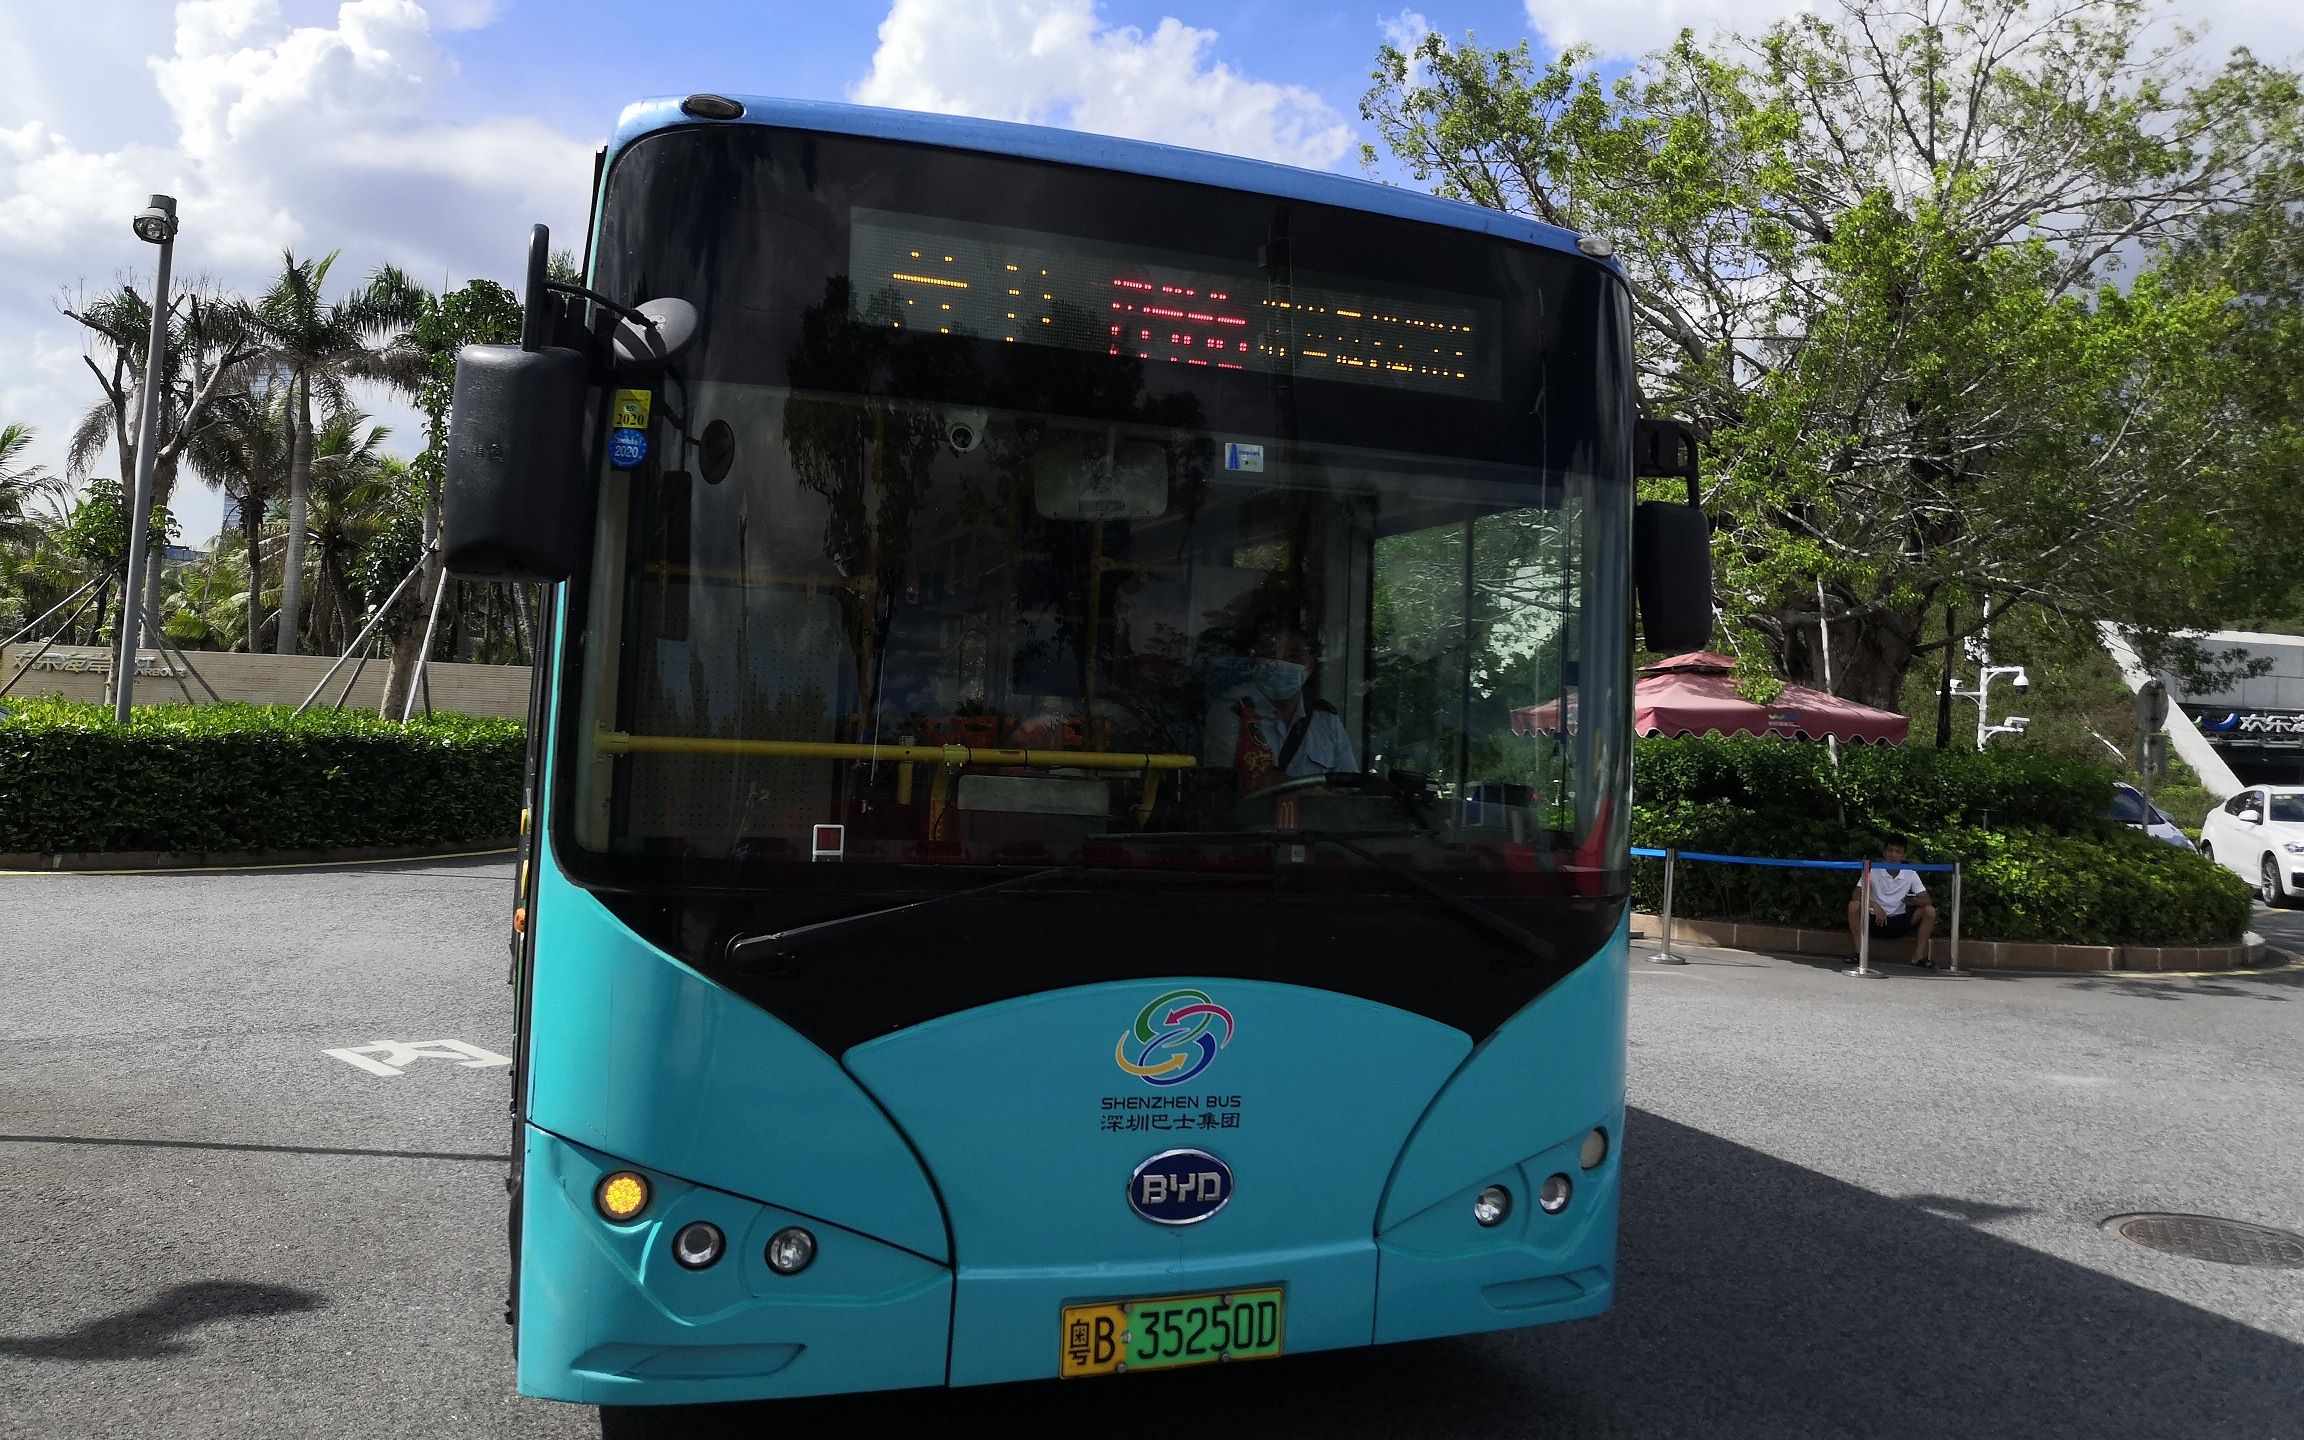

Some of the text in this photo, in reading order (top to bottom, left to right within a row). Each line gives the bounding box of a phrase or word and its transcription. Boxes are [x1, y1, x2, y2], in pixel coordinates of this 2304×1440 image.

[617, 413, 645, 426] 2020
[614, 445, 639, 458] 2020
[1101, 1095, 1241, 1110] SHENZHEN BUS
[1100, 1112, 1241, 1132] 深圳巴士集团
[1141, 1171, 1222, 1205] BYD
